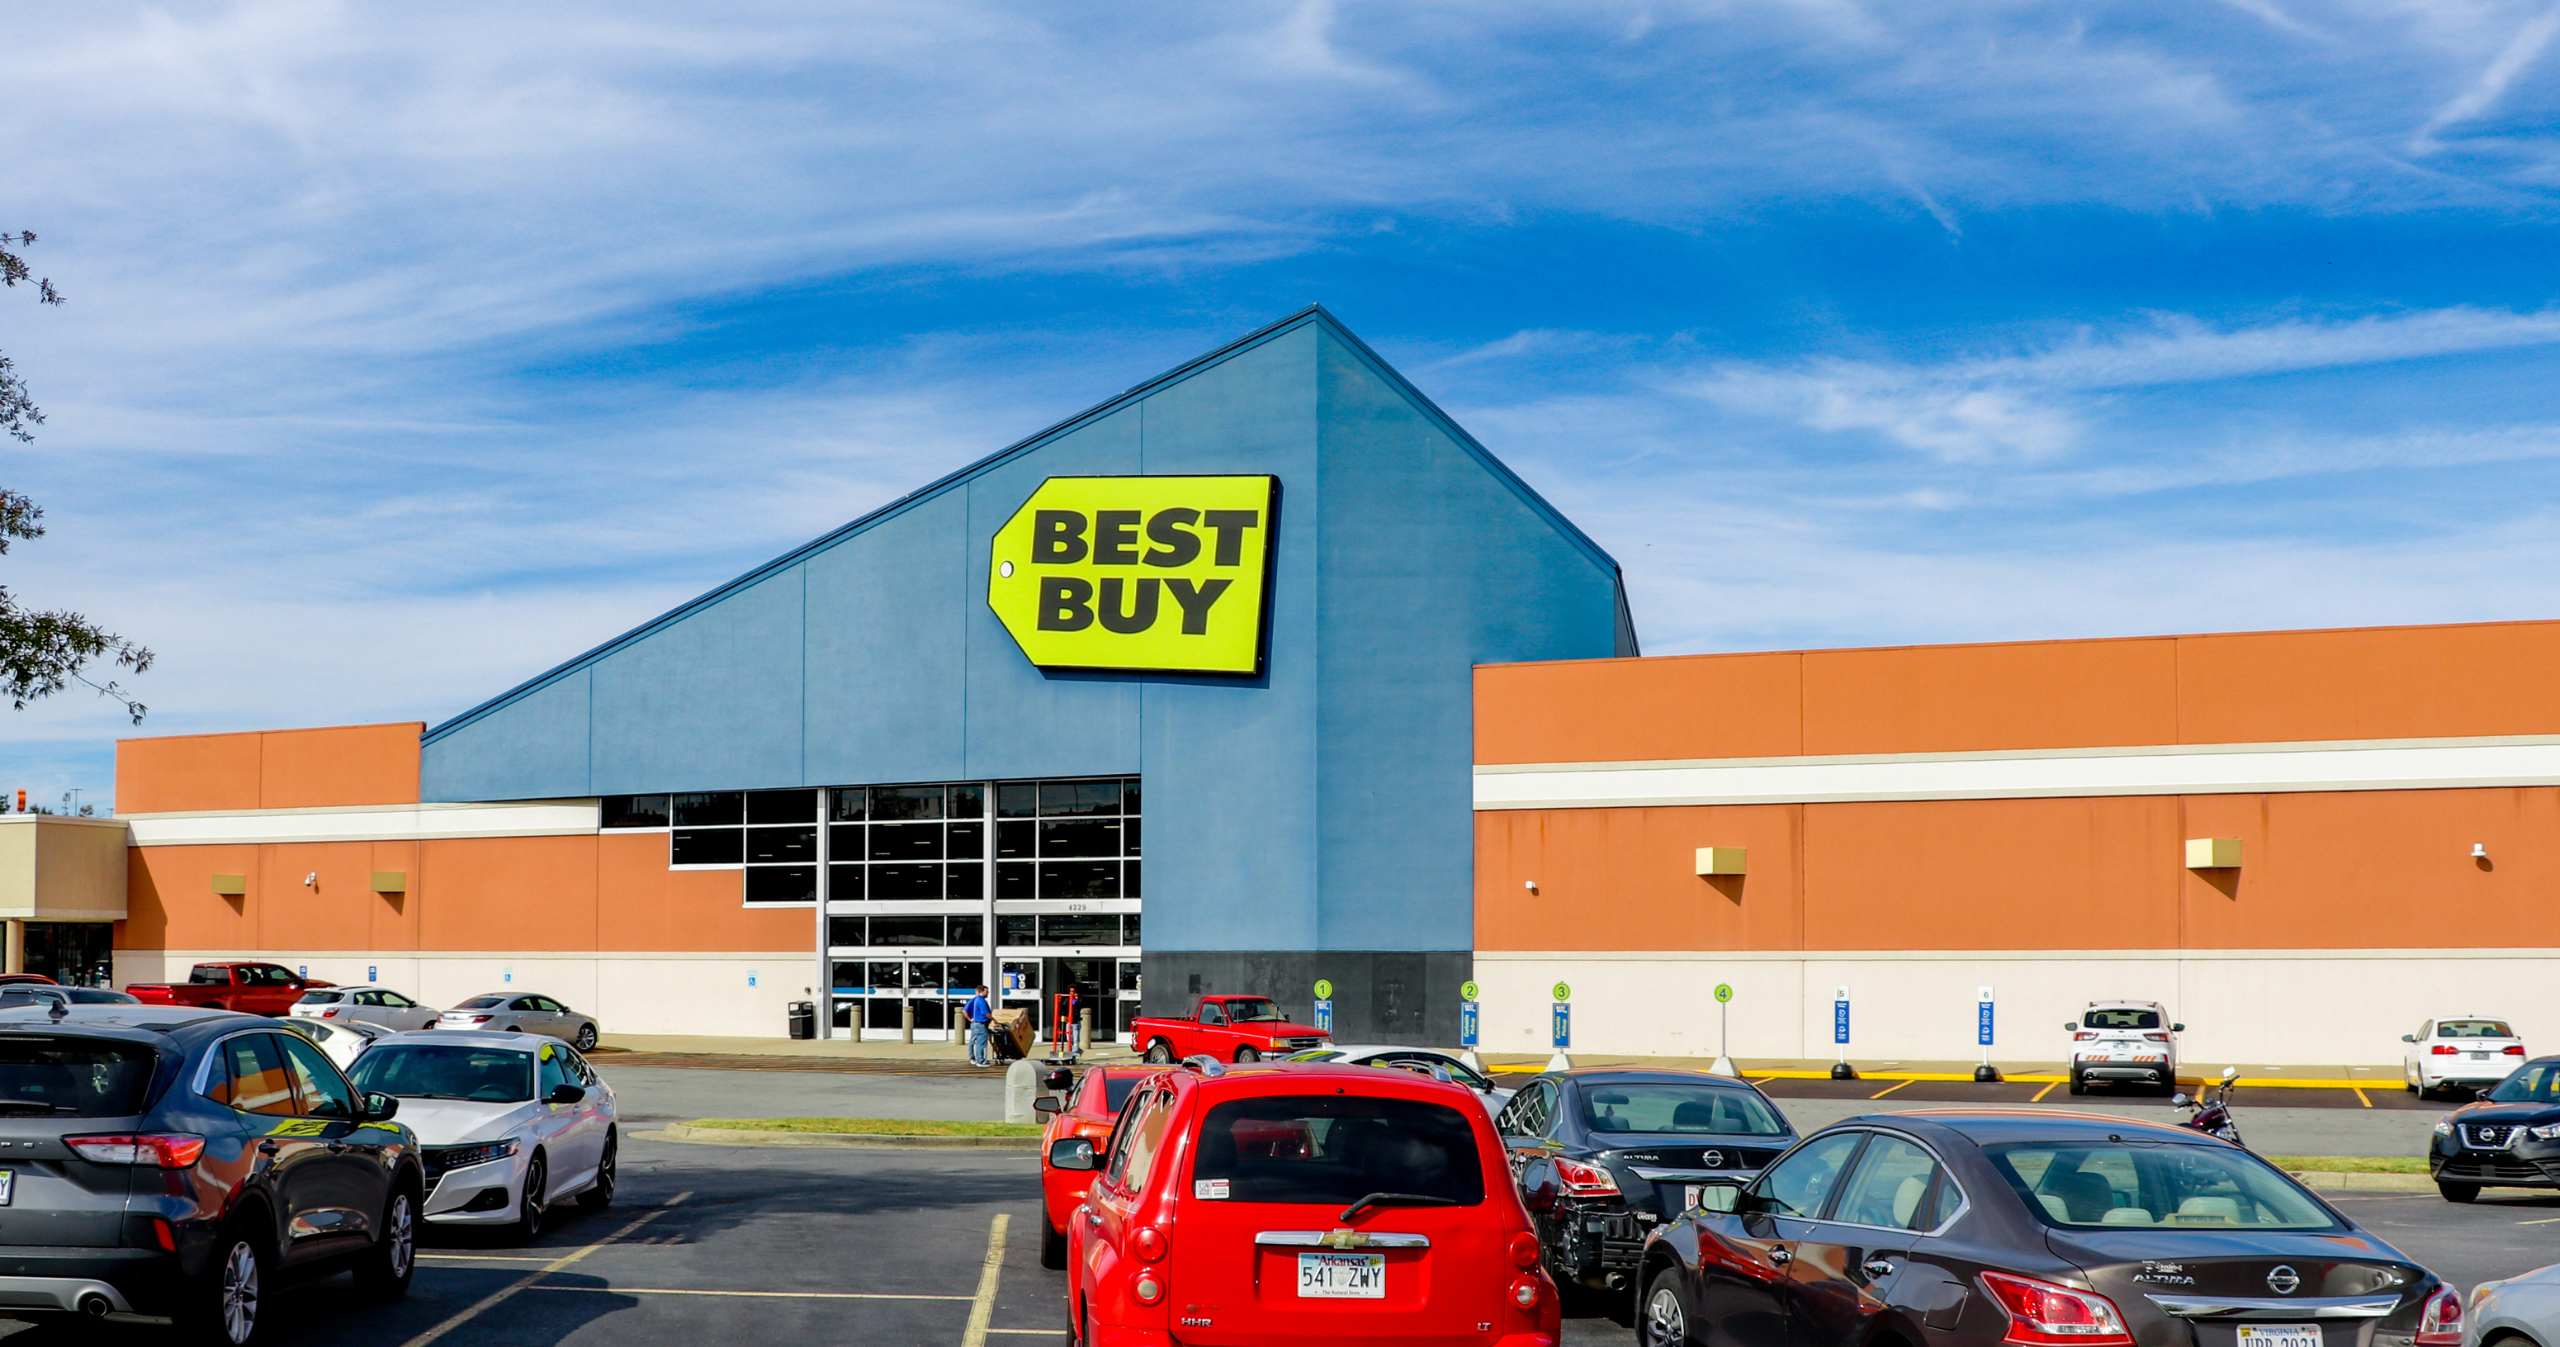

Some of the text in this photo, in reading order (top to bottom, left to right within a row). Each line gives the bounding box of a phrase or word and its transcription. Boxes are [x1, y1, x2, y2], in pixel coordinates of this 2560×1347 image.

[1031, 507, 1259, 568] BEST
[1037, 576, 1235, 636] BUY
[1319, 984, 1325, 995] 1
[1466, 985, 1474, 996] 2
[1558, 986, 1565, 998] 3
[1719, 988, 1727, 999] 4
[1839, 990, 1845, 998] 5
[1318, 1255, 1366, 1267] Arkansas
[1303, 1266, 1381, 1288] 541 ZWY
[2132, 1274, 2195, 1285] ALTIMA
[1181, 1317, 1212, 1327] HHR
[1477, 1322, 1491, 1331] LT
[2258, 1327, 2300, 1336] VIRGINIA
